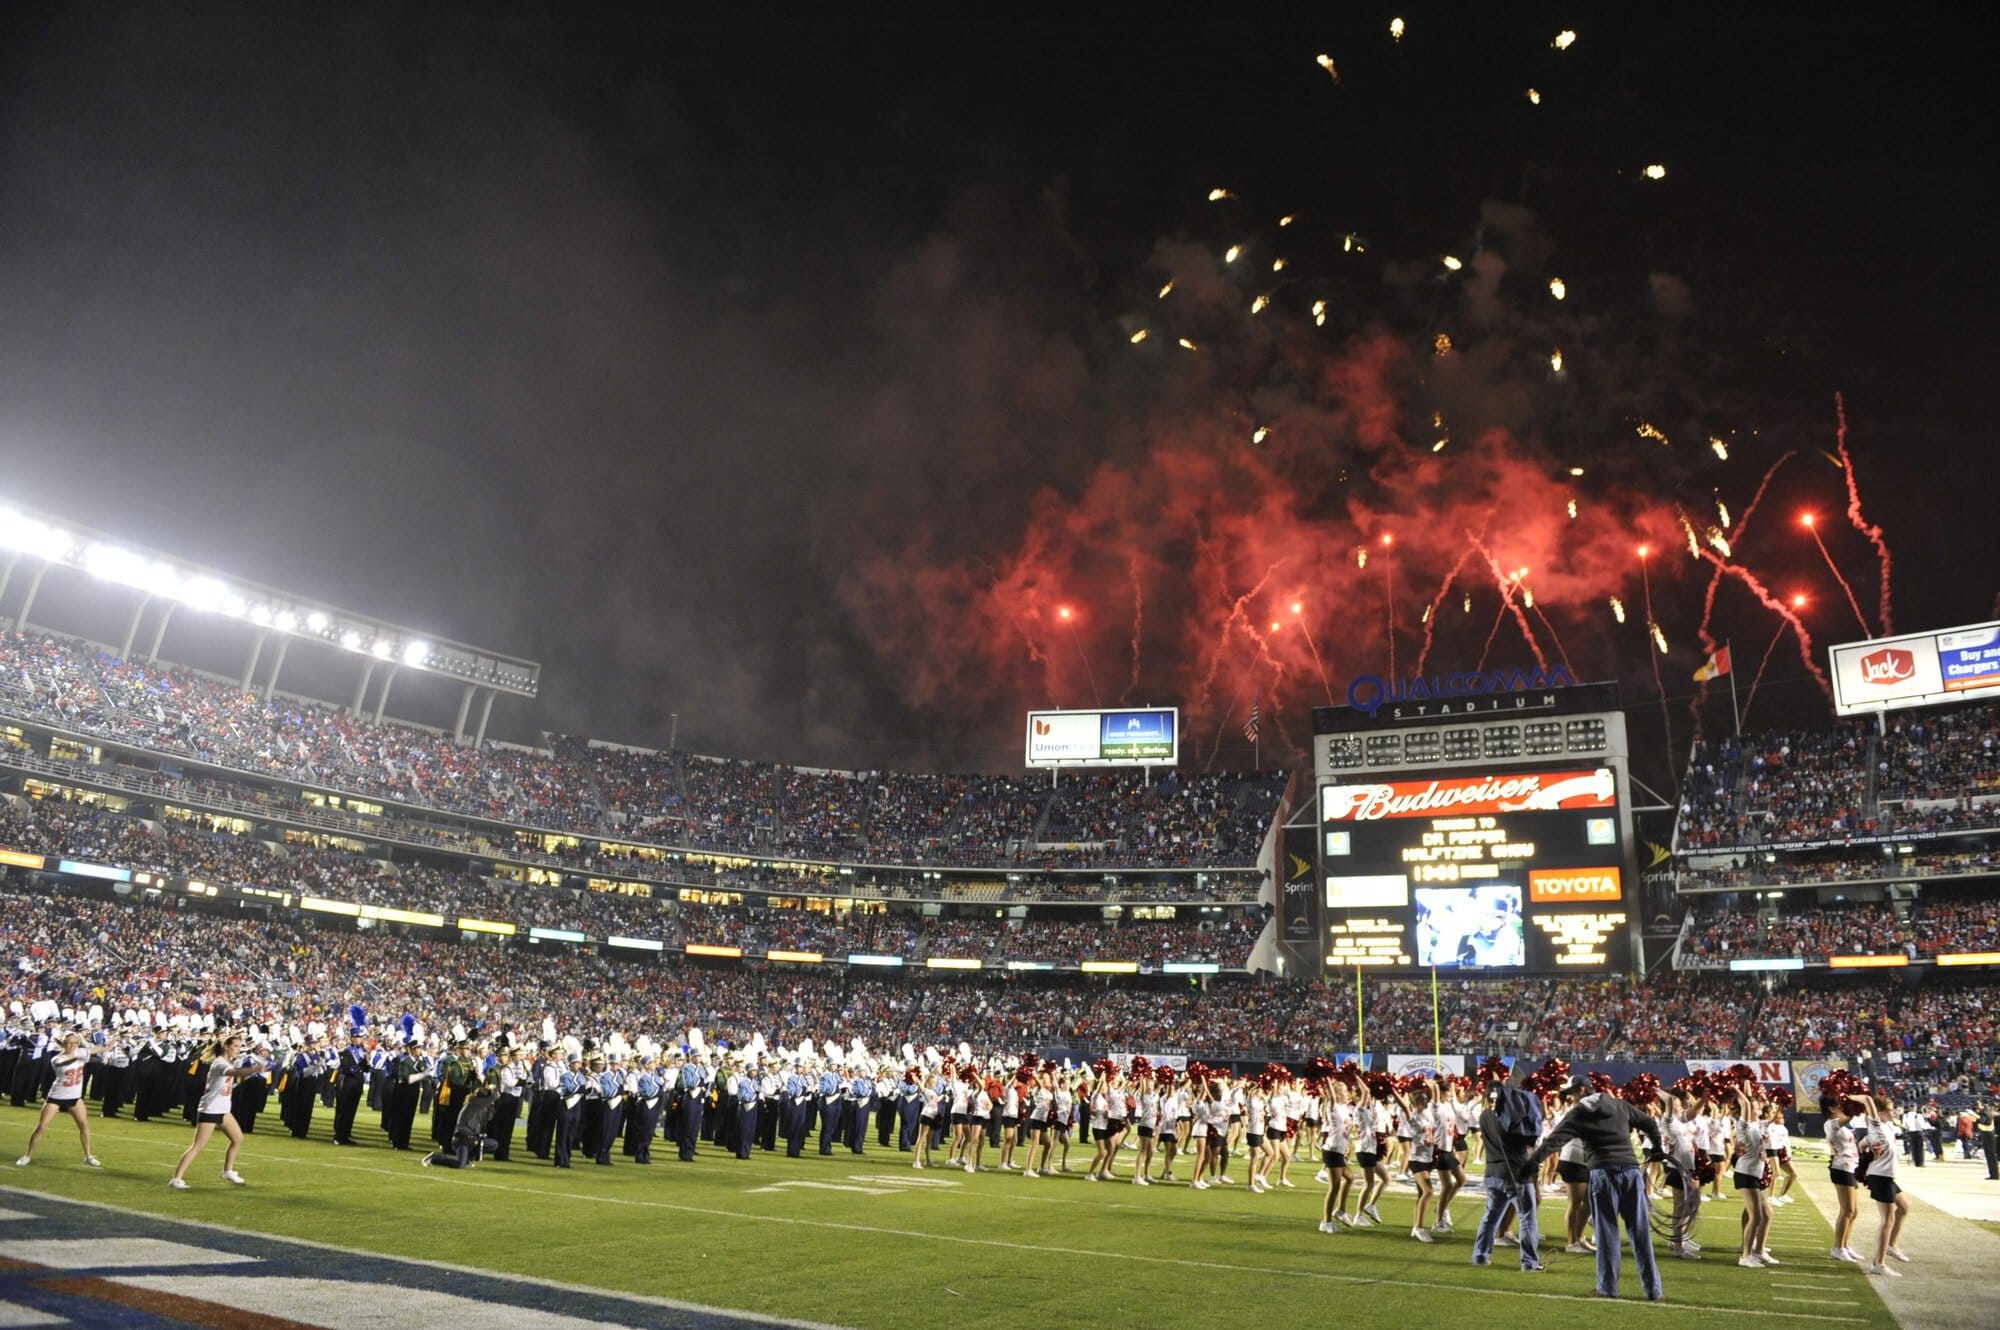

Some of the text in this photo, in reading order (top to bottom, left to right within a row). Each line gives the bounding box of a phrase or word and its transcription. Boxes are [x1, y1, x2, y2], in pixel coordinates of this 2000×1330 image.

[1960, 650, 1981, 662] Buy
[1864, 652, 1913, 682] Jack
[1948, 660, 1999, 676] Chargers
[1347, 663, 1573, 718] QUALCOMM
[1394, 695, 1555, 718] STADIUM
[1351, 776, 1540, 820] Budweiser
[1479, 817, 1497, 829] TO
[1422, 829, 1507, 846] DR PEPPER
[1402, 842, 1535, 862] HALFTIME SHOW
[1534, 876, 1617, 895] TOYOTA
[1641, 871, 1676, 884] Sprint
[1285, 882, 1313, 895] Sprint
[1760, 1063, 1782, 1081] N
